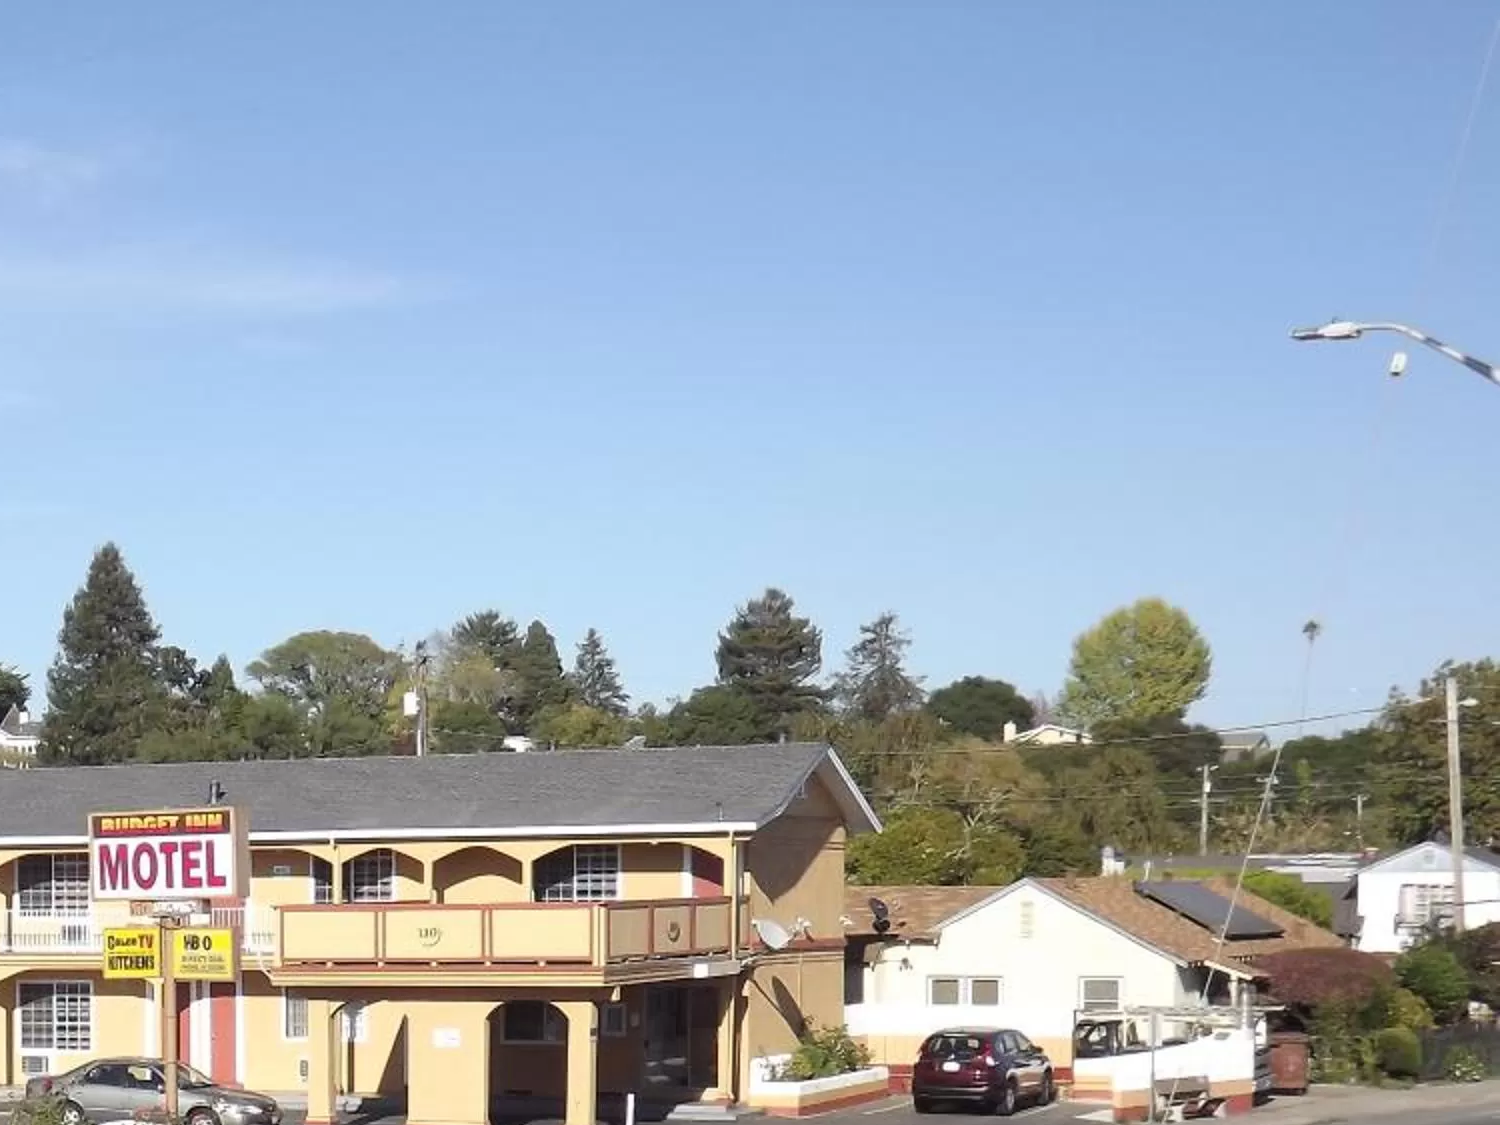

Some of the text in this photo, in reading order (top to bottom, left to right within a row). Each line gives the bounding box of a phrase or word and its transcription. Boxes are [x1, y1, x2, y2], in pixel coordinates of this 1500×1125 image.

[100, 812, 224, 835] BUDGET INN
[98, 840, 227, 890] MOTEL
[138, 933, 155, 949] TV
[107, 954, 155, 971] KITCHENS
